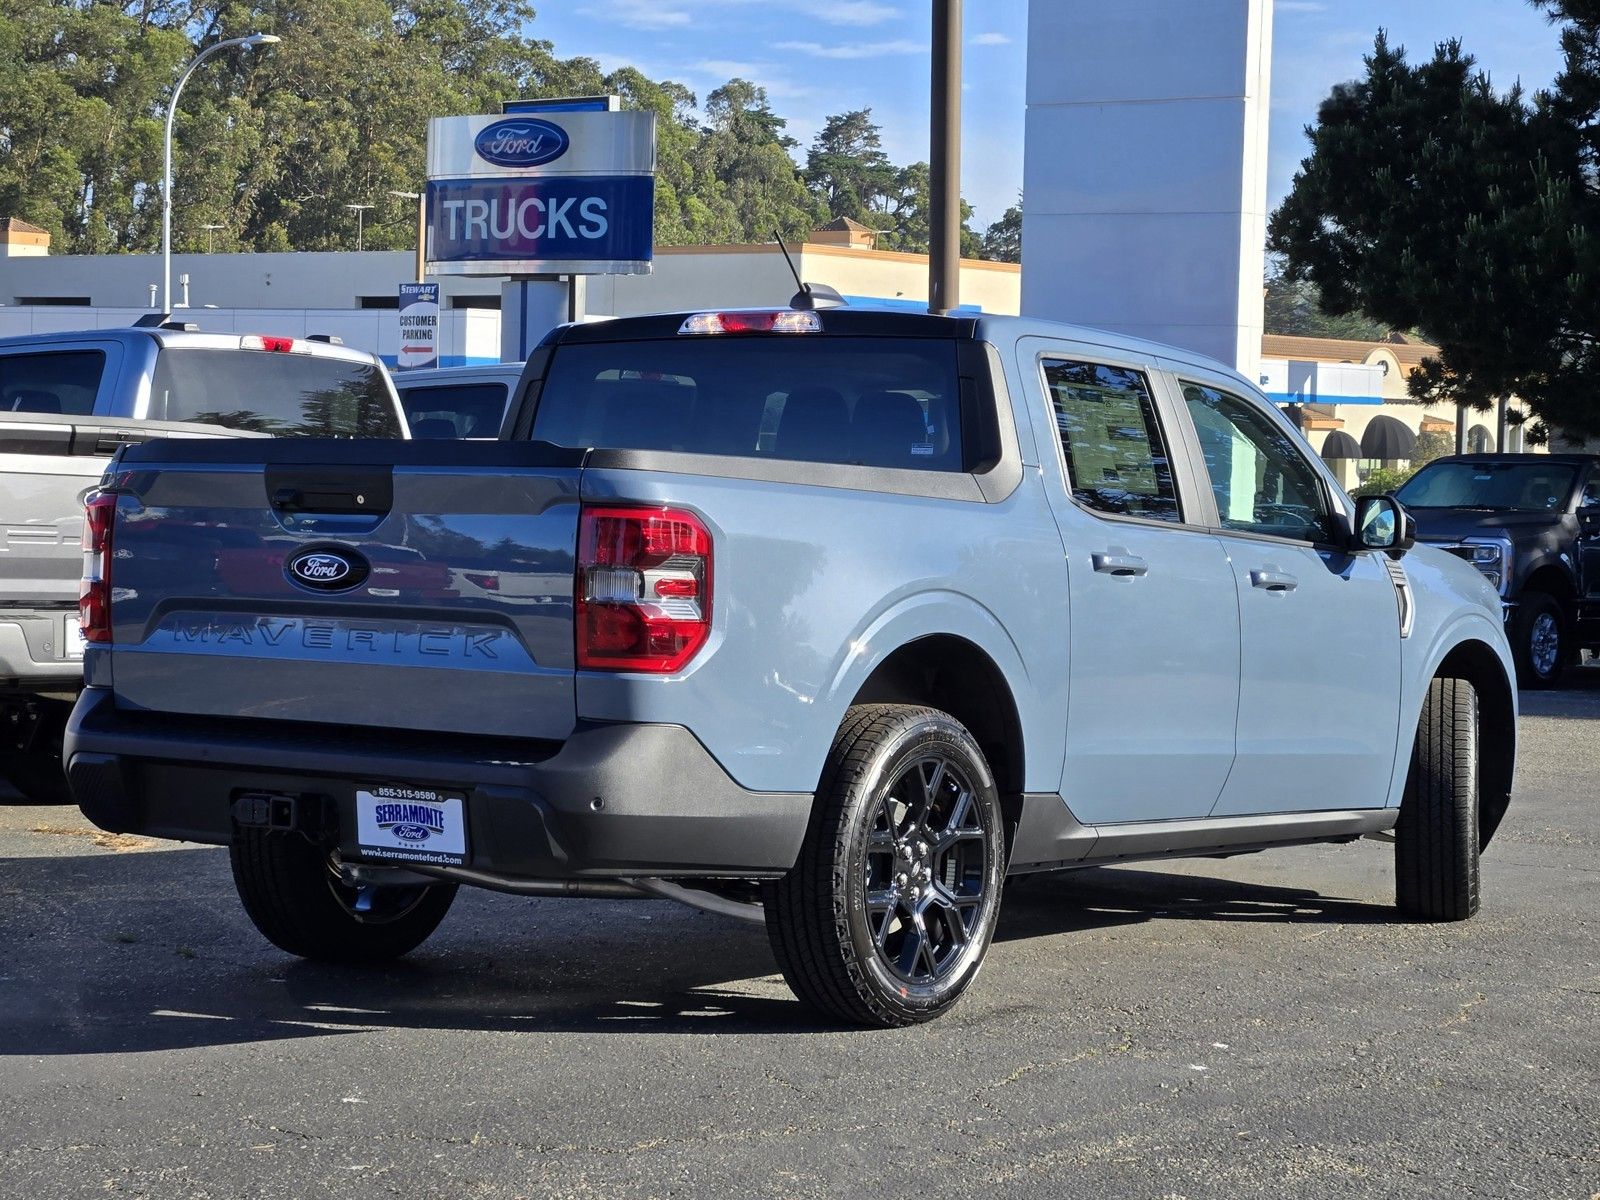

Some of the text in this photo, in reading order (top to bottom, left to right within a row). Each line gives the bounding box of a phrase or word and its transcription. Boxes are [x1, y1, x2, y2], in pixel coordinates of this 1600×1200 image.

[491, 128, 543, 154] Ford
[443, 197, 608, 240] TRUCKS
[401, 284, 437, 294] STEWART
[400, 315, 437, 327] CUSTOMER
[402, 329, 433, 340] PARKING
[303, 557, 338, 576] Ford
[173, 620, 499, 659] MAVERICK
[378, 787, 436, 800] 855-315-9580
[375, 804, 444, 829] SERRAMONTE
[398, 825, 423, 839] Ford
[360, 847, 462, 865] www.serramonteford.com
